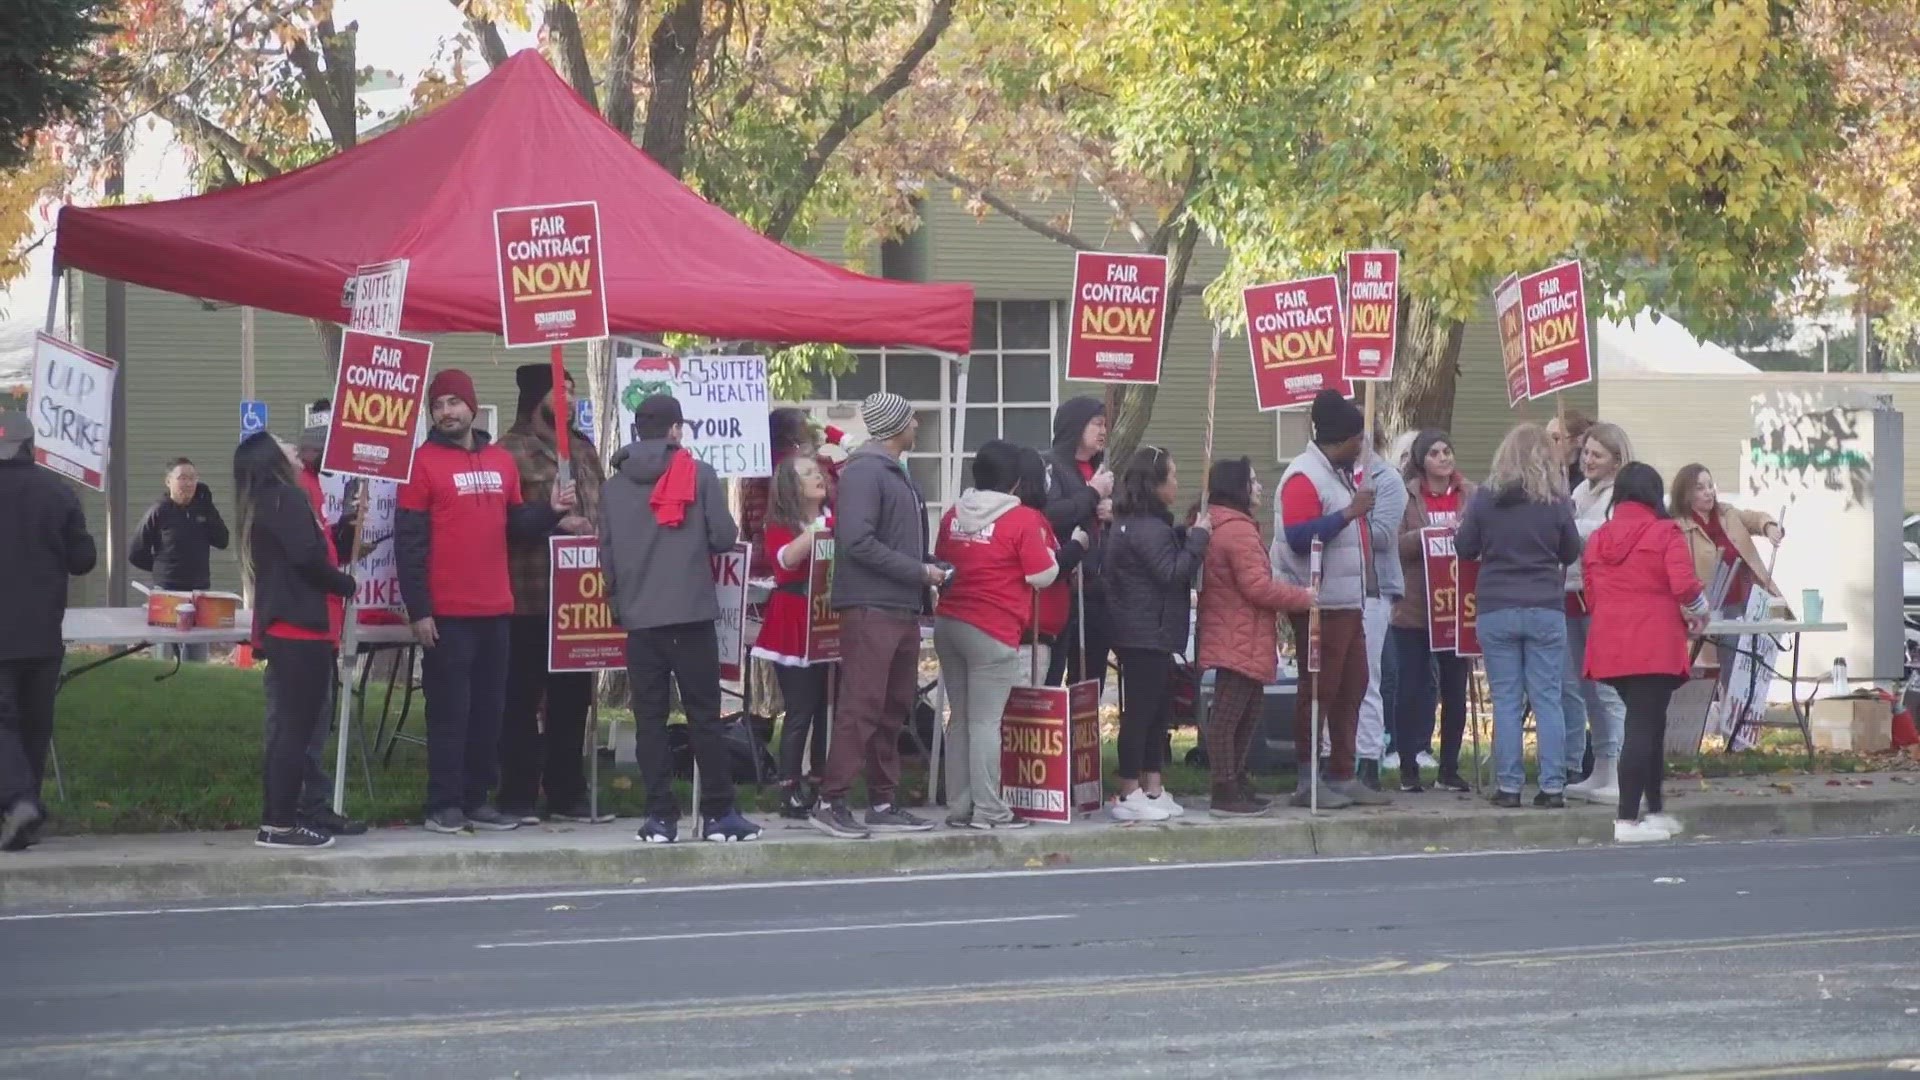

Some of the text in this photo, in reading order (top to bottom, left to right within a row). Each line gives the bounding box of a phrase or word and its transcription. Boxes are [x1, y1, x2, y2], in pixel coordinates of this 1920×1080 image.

[531, 215, 566, 237] FAIR
[507, 235, 592, 260] CONTRACT
[512, 259, 591, 295] NOW
[1107, 263, 1138, 283] FAIR
[1364, 260, 1383, 279] FAIR
[1082, 283, 1160, 305] CONTRACT
[1275, 289, 1309, 311] FAIR
[1351, 281, 1394, 300] CONTRACT
[1539, 277, 1560, 299] FAIR
[352, 303, 394, 331] HEALTH
[1255, 305, 1334, 333] CONTRACT
[1351, 303, 1392, 332] NOW
[1527, 290, 1578, 322] CONTRACT
[1081, 304, 1156, 335] NOW
[1529, 311, 1578, 353] NOW
[371, 345, 403, 369] FAIR
[1260, 326, 1335, 364] NOW
[346, 364, 420, 394] CONTRACT
[710, 359, 765, 381] SUTTER
[707, 383, 766, 403] HEALTH
[341, 388, 414, 430] NOW
[37, 395, 104, 457] STRIKE
[687, 417, 743, 440] YOUR
[559, 547, 600, 568] NU
[557, 603, 613, 630] STRI
[1002, 726, 1064, 757] STRIKE
[1019, 757, 1047, 785] ON
[1003, 786, 1064, 812] NUHW
